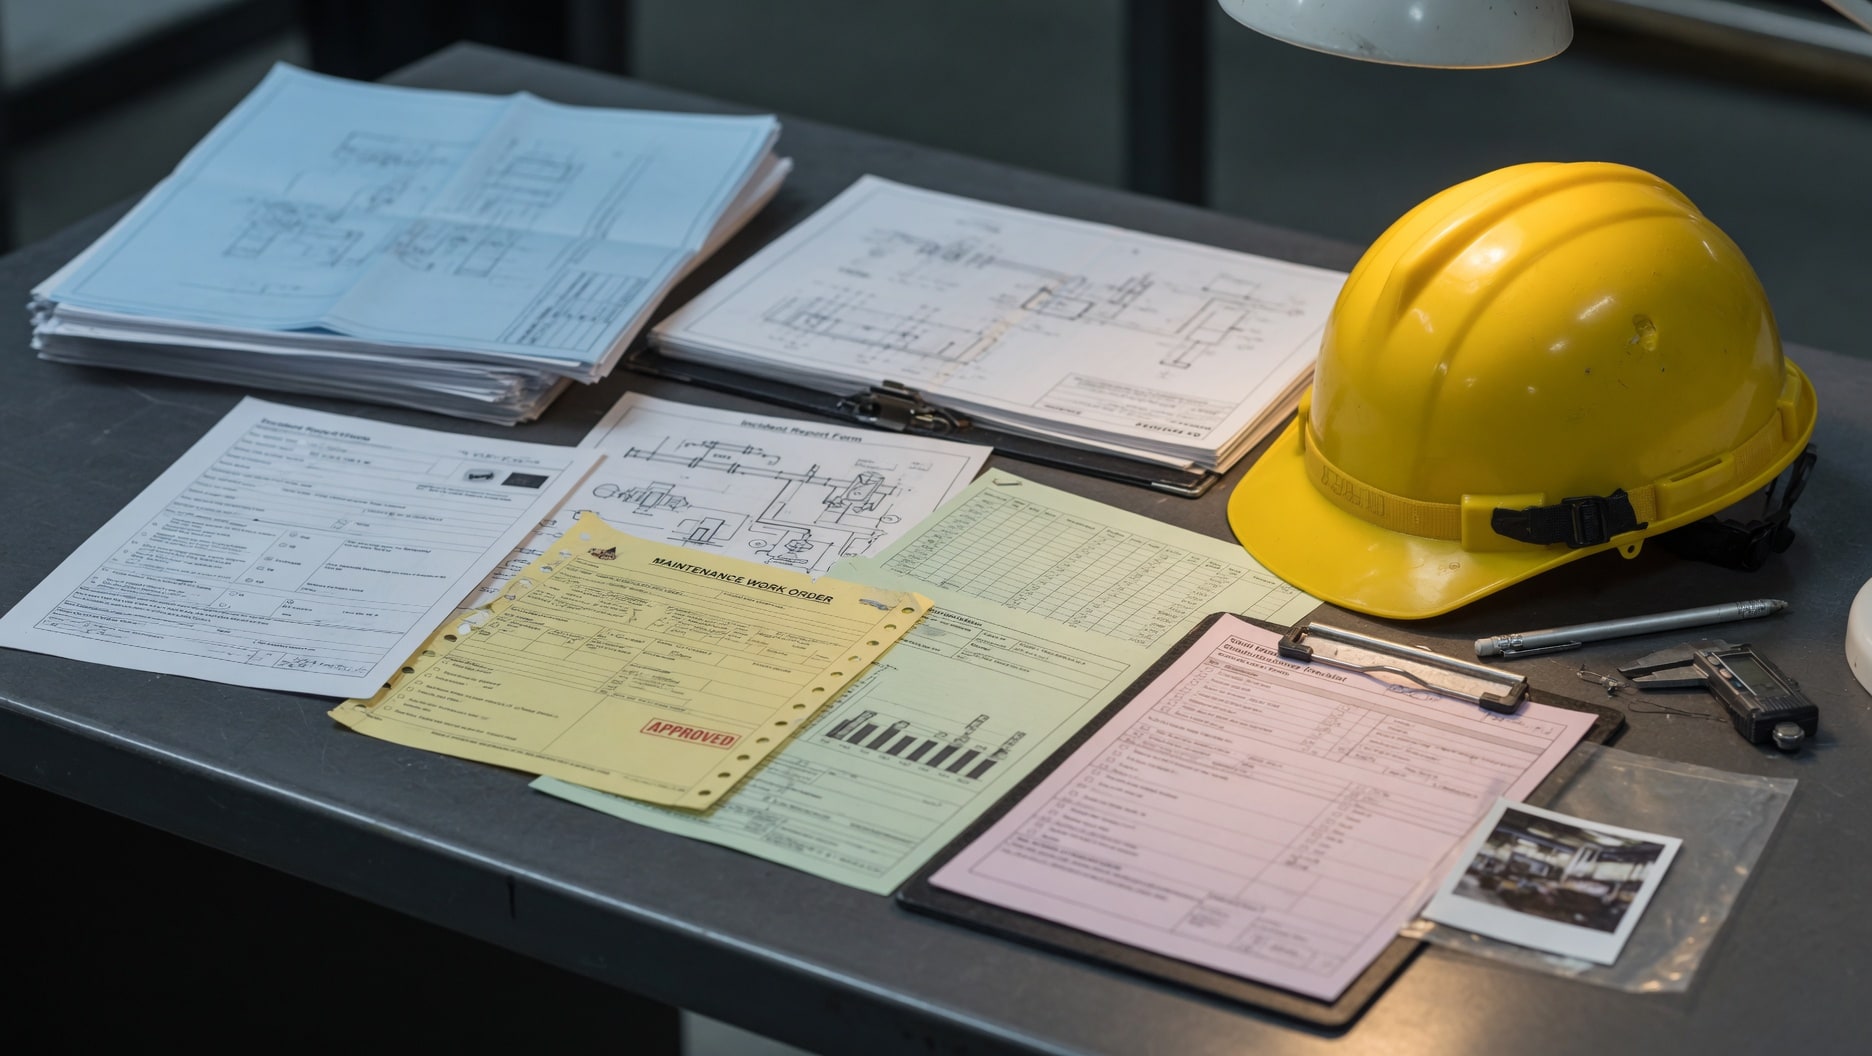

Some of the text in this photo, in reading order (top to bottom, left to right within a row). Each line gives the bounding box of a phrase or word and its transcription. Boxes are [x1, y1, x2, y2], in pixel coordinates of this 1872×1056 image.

[741, 420, 862, 443] Incident Report Form
[652, 557, 745, 584] MAINTENANCE
[747, 578, 787, 594] WORK
[788, 588, 834, 603] ORDER
[646, 721, 735, 746] APPROVED
